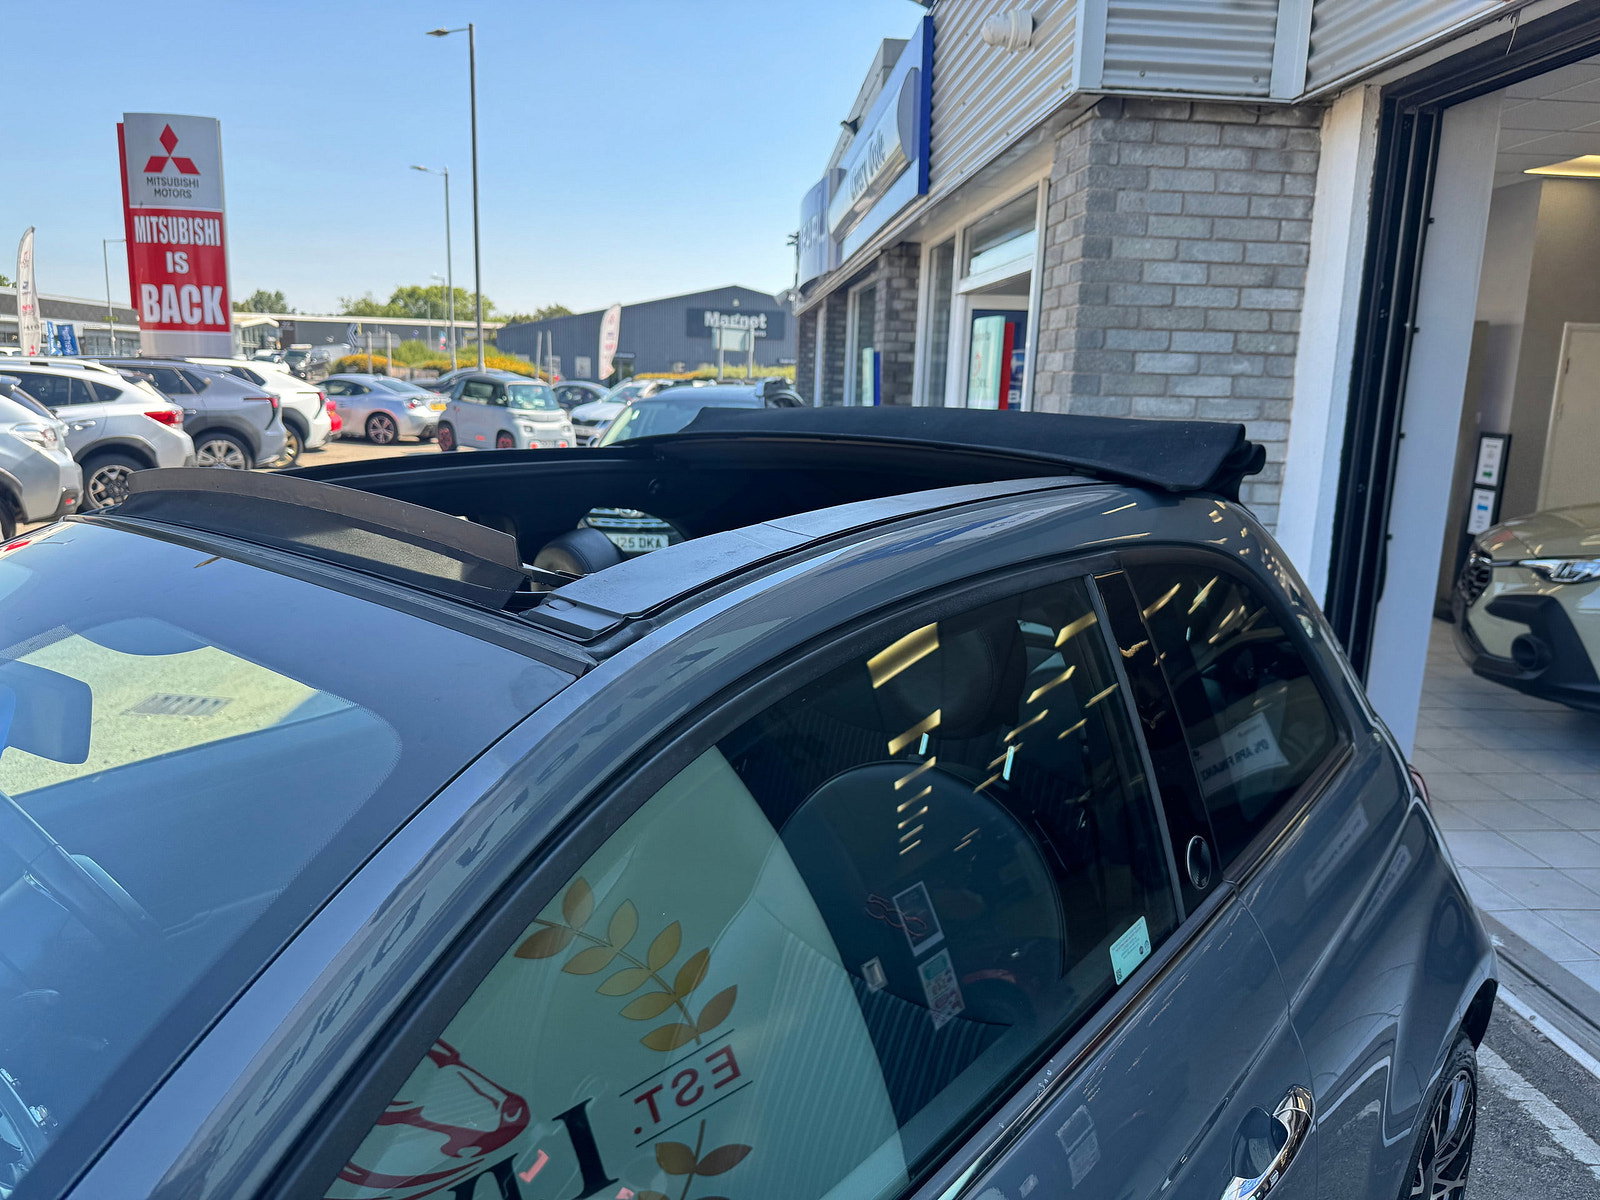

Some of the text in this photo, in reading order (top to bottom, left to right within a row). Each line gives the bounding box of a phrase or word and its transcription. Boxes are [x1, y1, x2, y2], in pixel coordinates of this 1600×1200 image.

[146, 176, 200, 189] MITSUBISHI
[154, 188, 193, 199] MOTORS
[133, 215, 222, 247] MITSUBISHI
[165, 250, 190, 274] IS
[140, 283, 226, 326] BACK
[704, 310, 768, 330] Magnet
[638, 537, 662, 549] DKA
